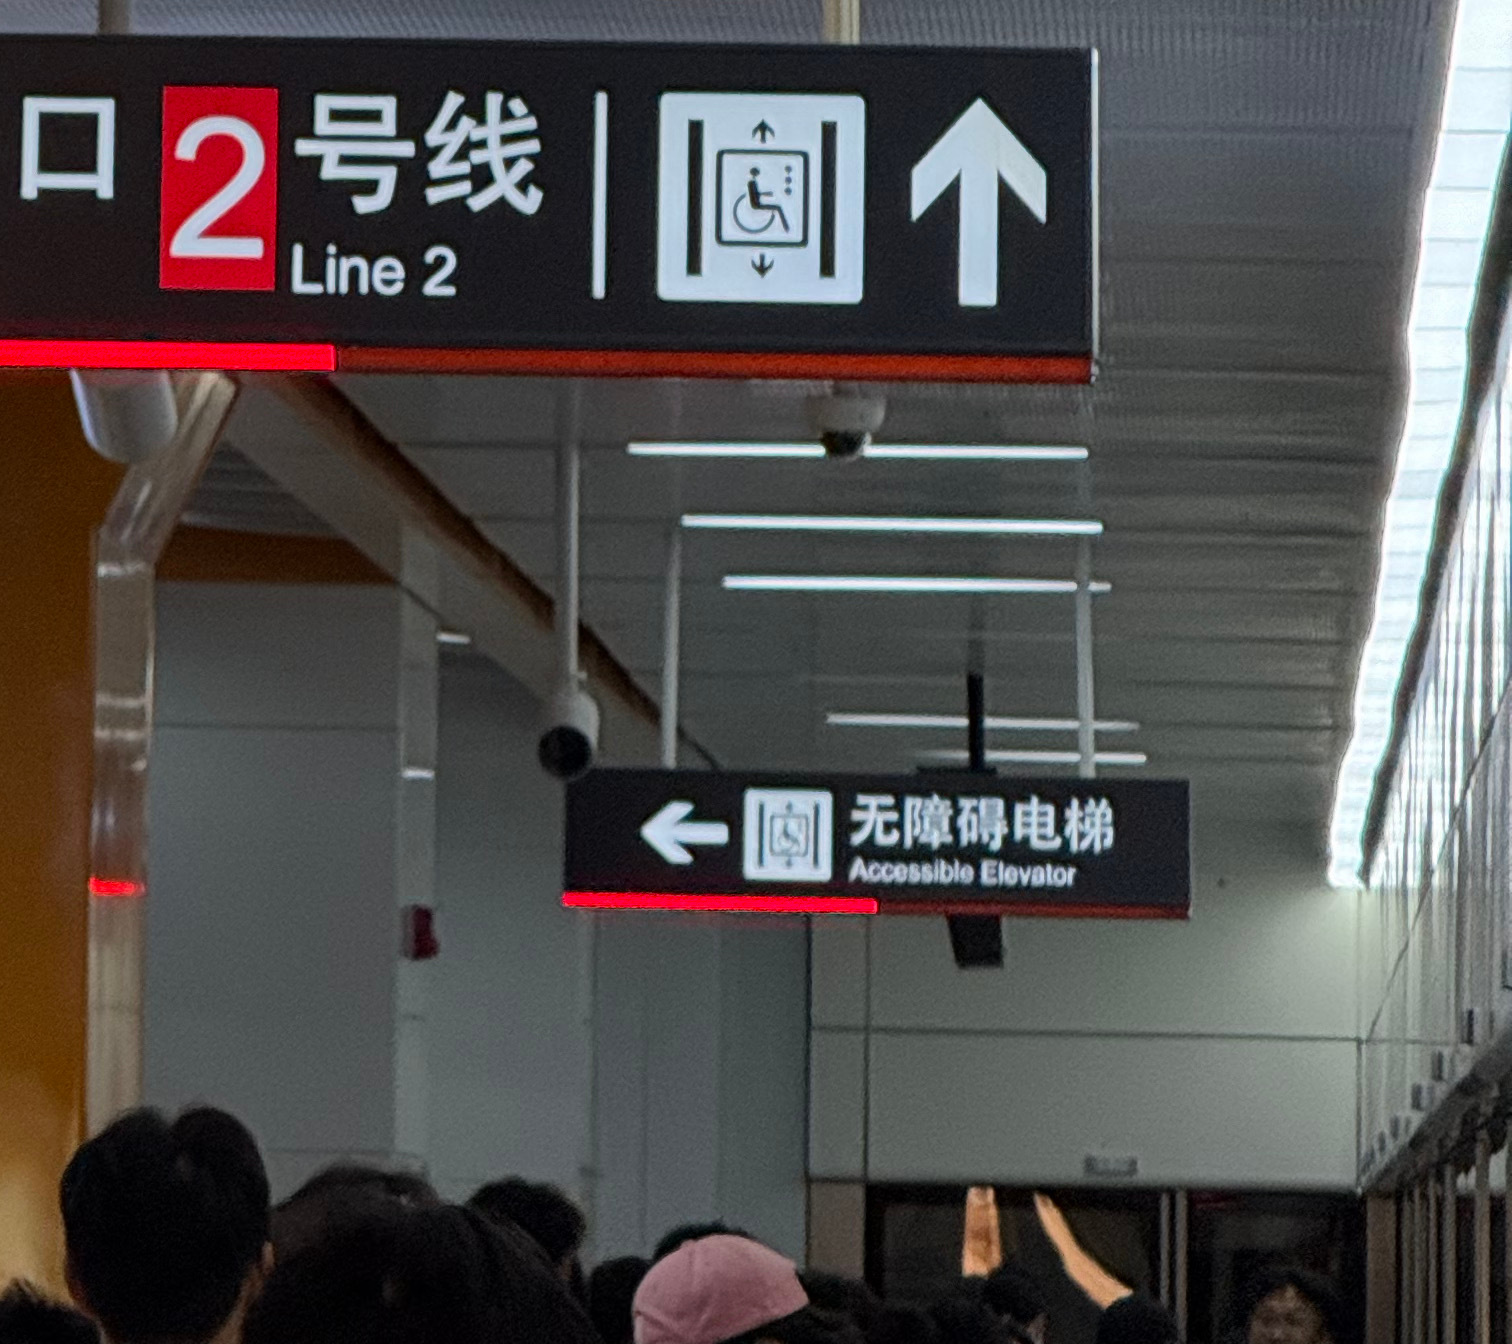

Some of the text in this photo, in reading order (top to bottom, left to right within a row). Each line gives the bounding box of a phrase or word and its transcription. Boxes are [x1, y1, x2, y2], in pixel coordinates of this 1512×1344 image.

[292, 244, 456, 296] Line 2
[851, 794, 1113, 853] 无障碍电梯
[849, 857, 1076, 887] Accessible Elevator
